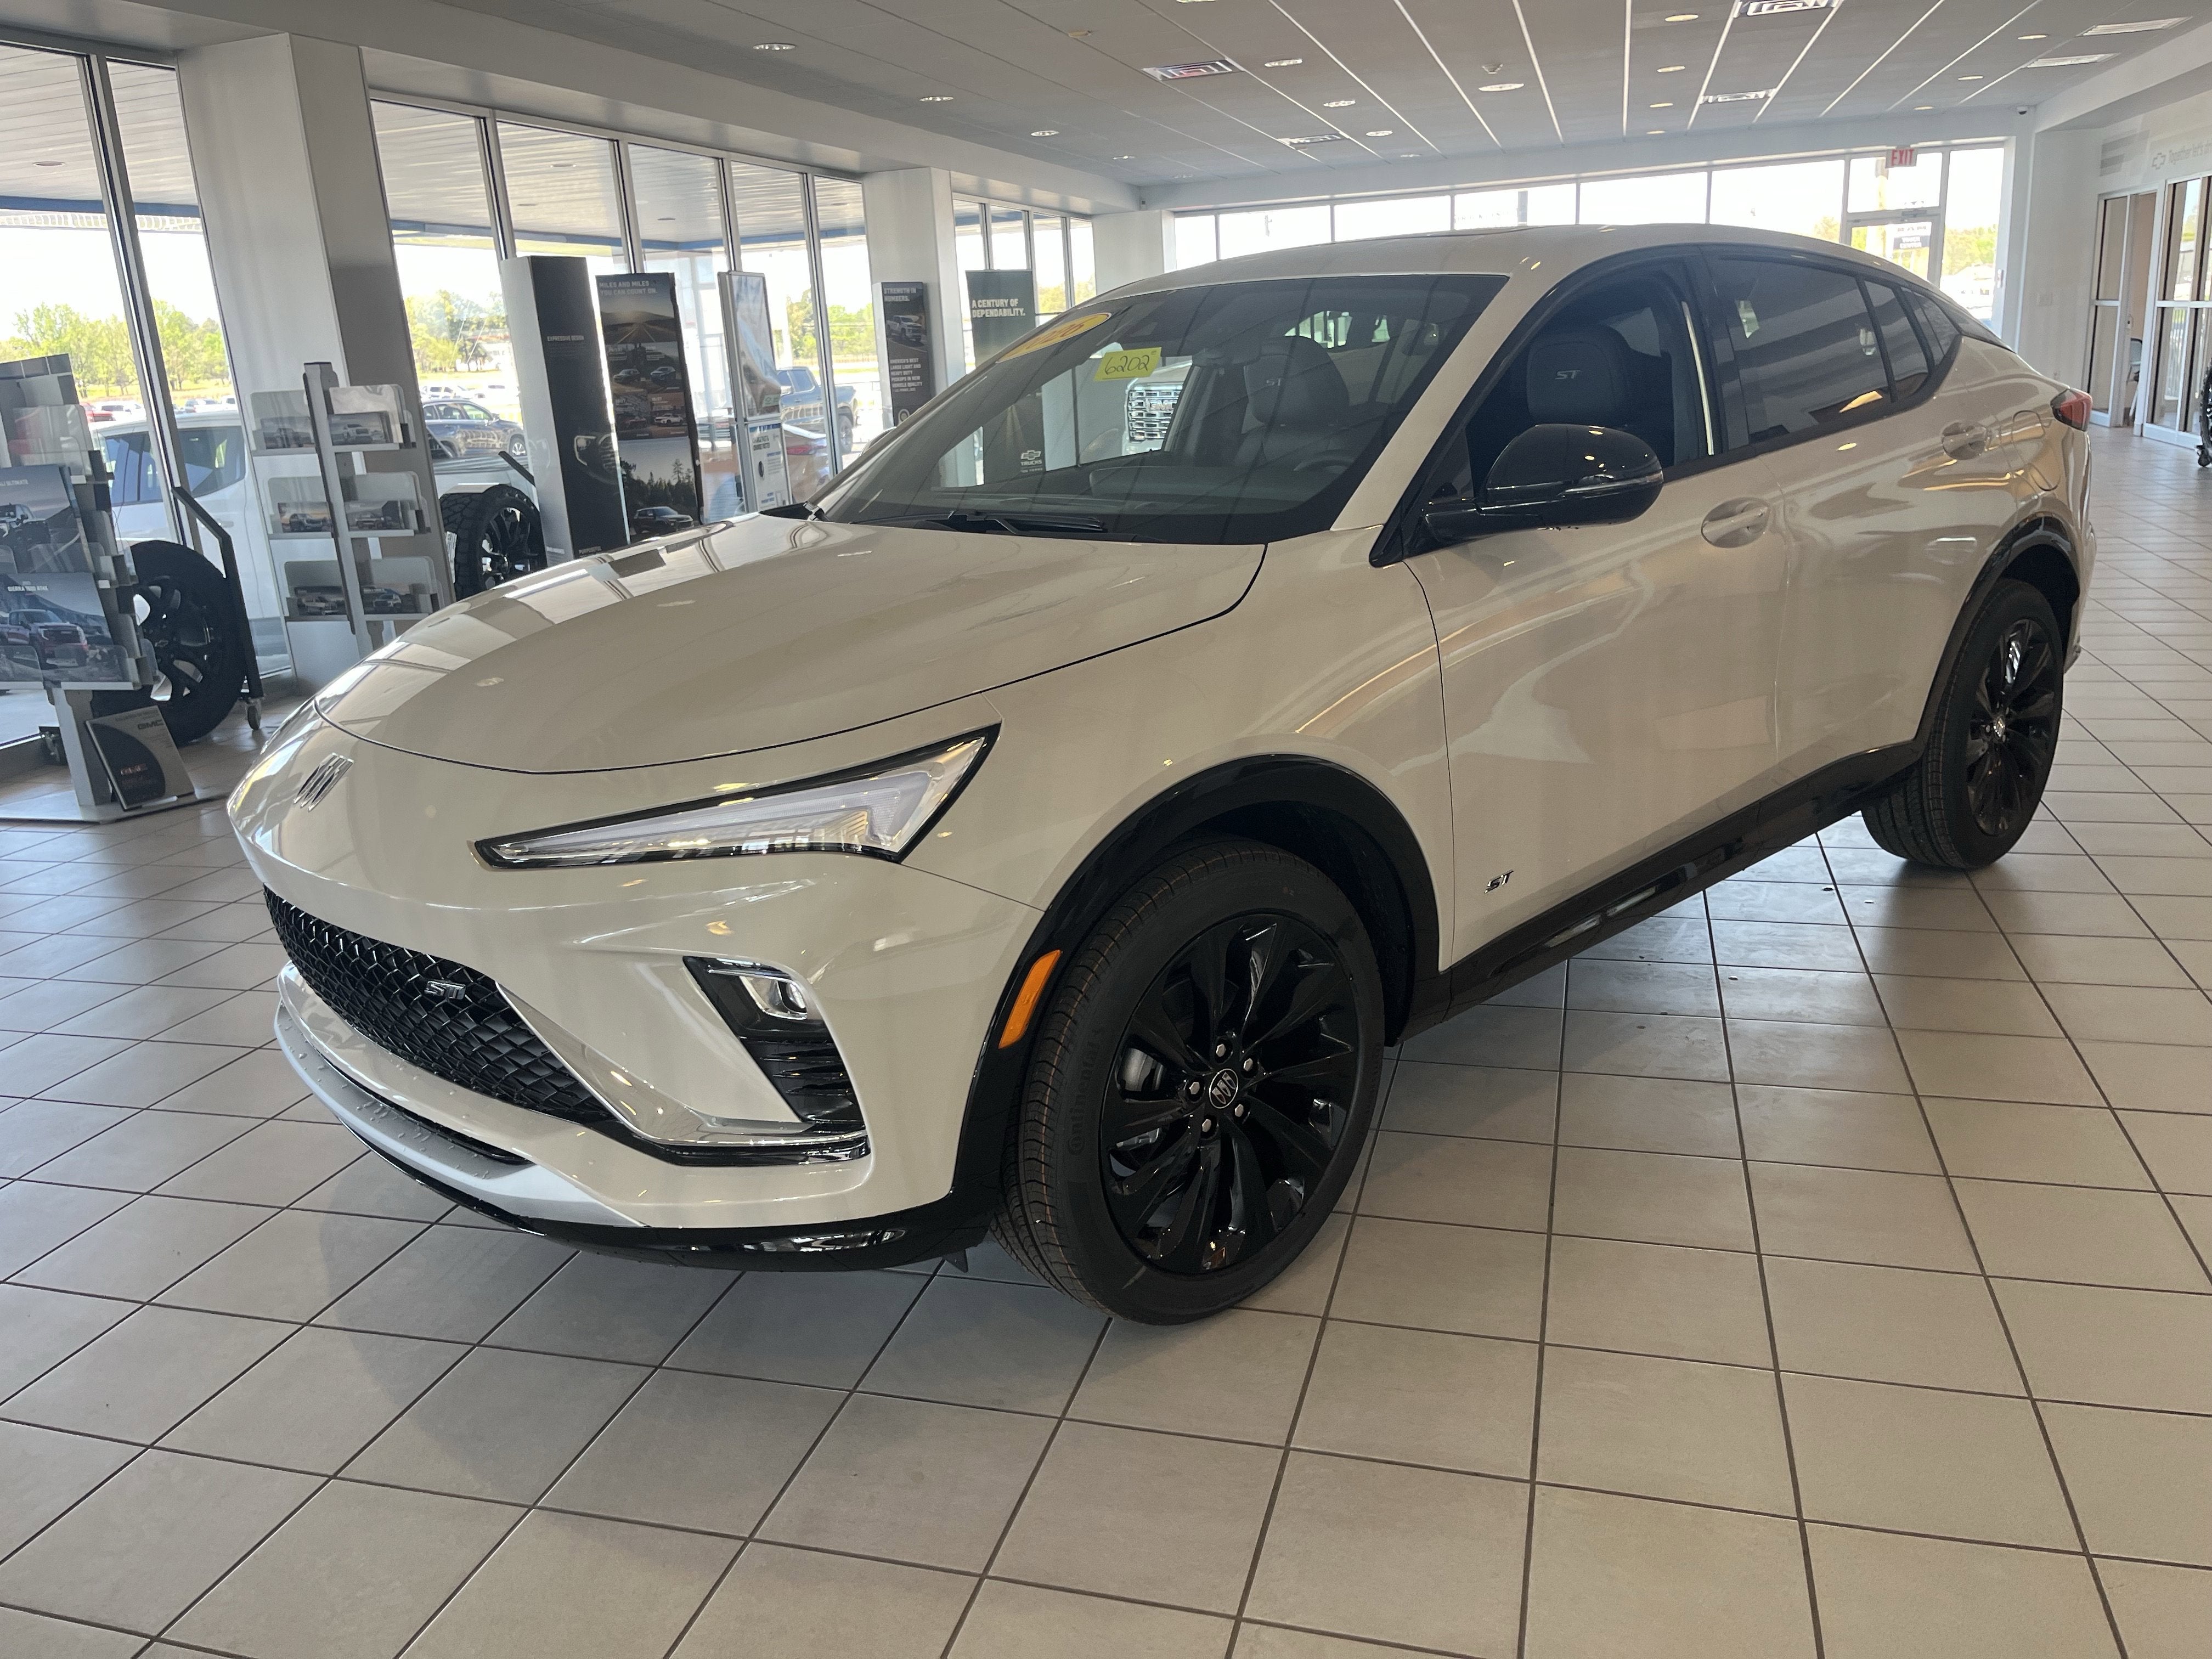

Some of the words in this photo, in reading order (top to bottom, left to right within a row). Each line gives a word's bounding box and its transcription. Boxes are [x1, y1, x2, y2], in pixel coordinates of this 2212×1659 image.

[1891, 149, 1915, 166] EXIT
[972, 300, 977, 308] A
[978, 298, 1008, 307] CENTURY
[1010, 298, 1019, 307] OF
[972, 308, 1026, 318] DEPENDABILITY.
[1104, 354, 1150, 375] 6202
[1555, 370, 1581, 380] ST
[137, 719, 165, 730] GMC
[1485, 869, 1514, 893] ST
[424, 980, 466, 1000] ST
[1066, 1041, 1100, 1155] Continental
